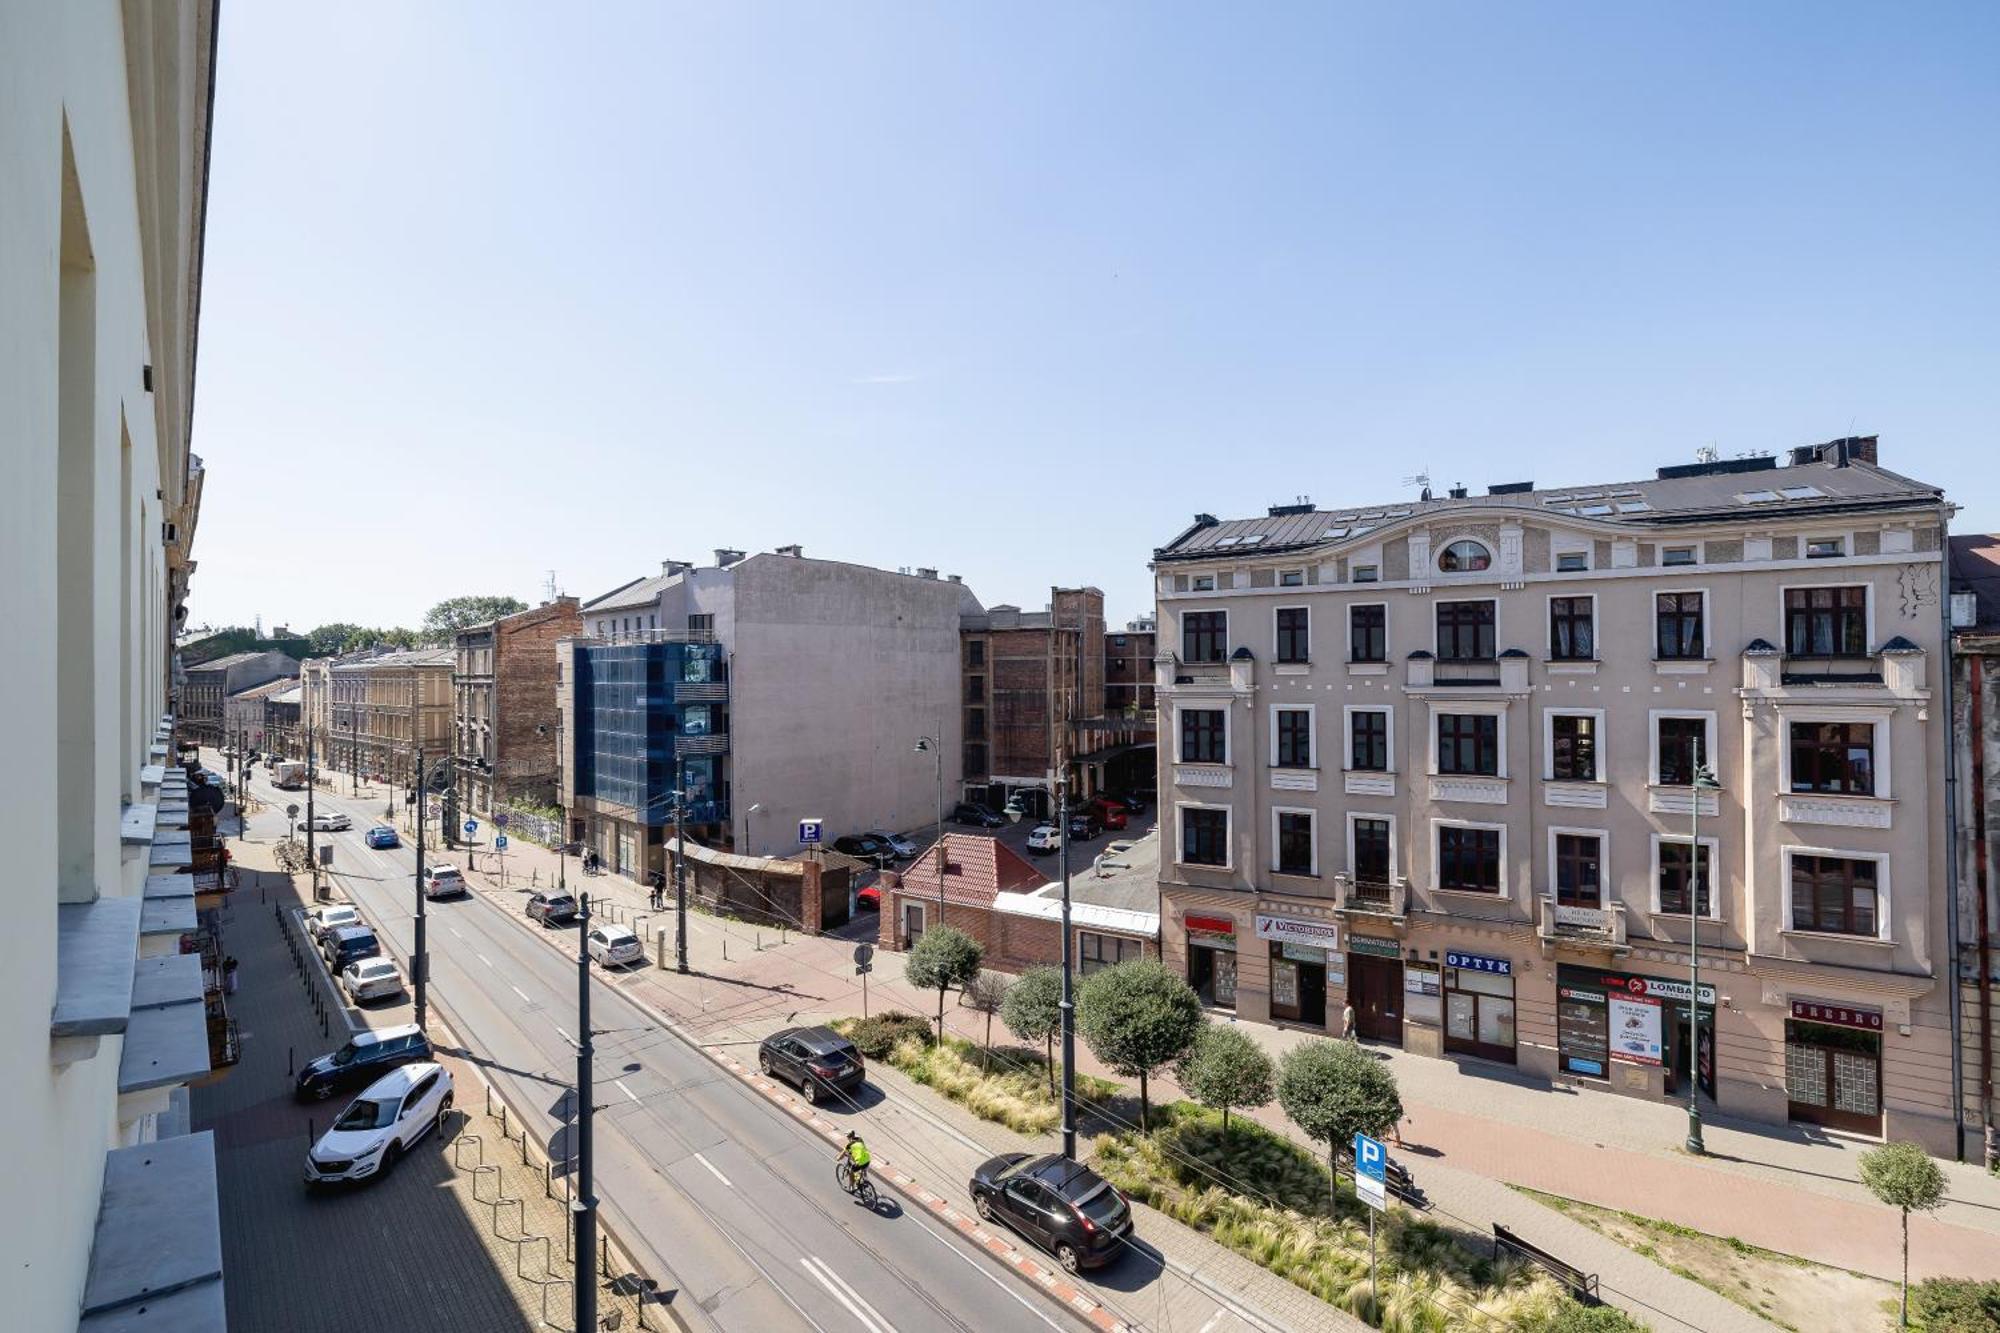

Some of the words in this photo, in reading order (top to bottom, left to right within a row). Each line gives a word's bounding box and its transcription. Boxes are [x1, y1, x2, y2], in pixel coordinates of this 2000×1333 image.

[804, 825, 816, 838] P
[1351, 936, 1399, 949] DERMATOLOG
[1447, 954, 1510, 974] OPTYK
[1650, 981, 1711, 998] LOMBARD
[1794, 1004, 1881, 1026] SREBRO
[1362, 1140, 1379, 1163] P
